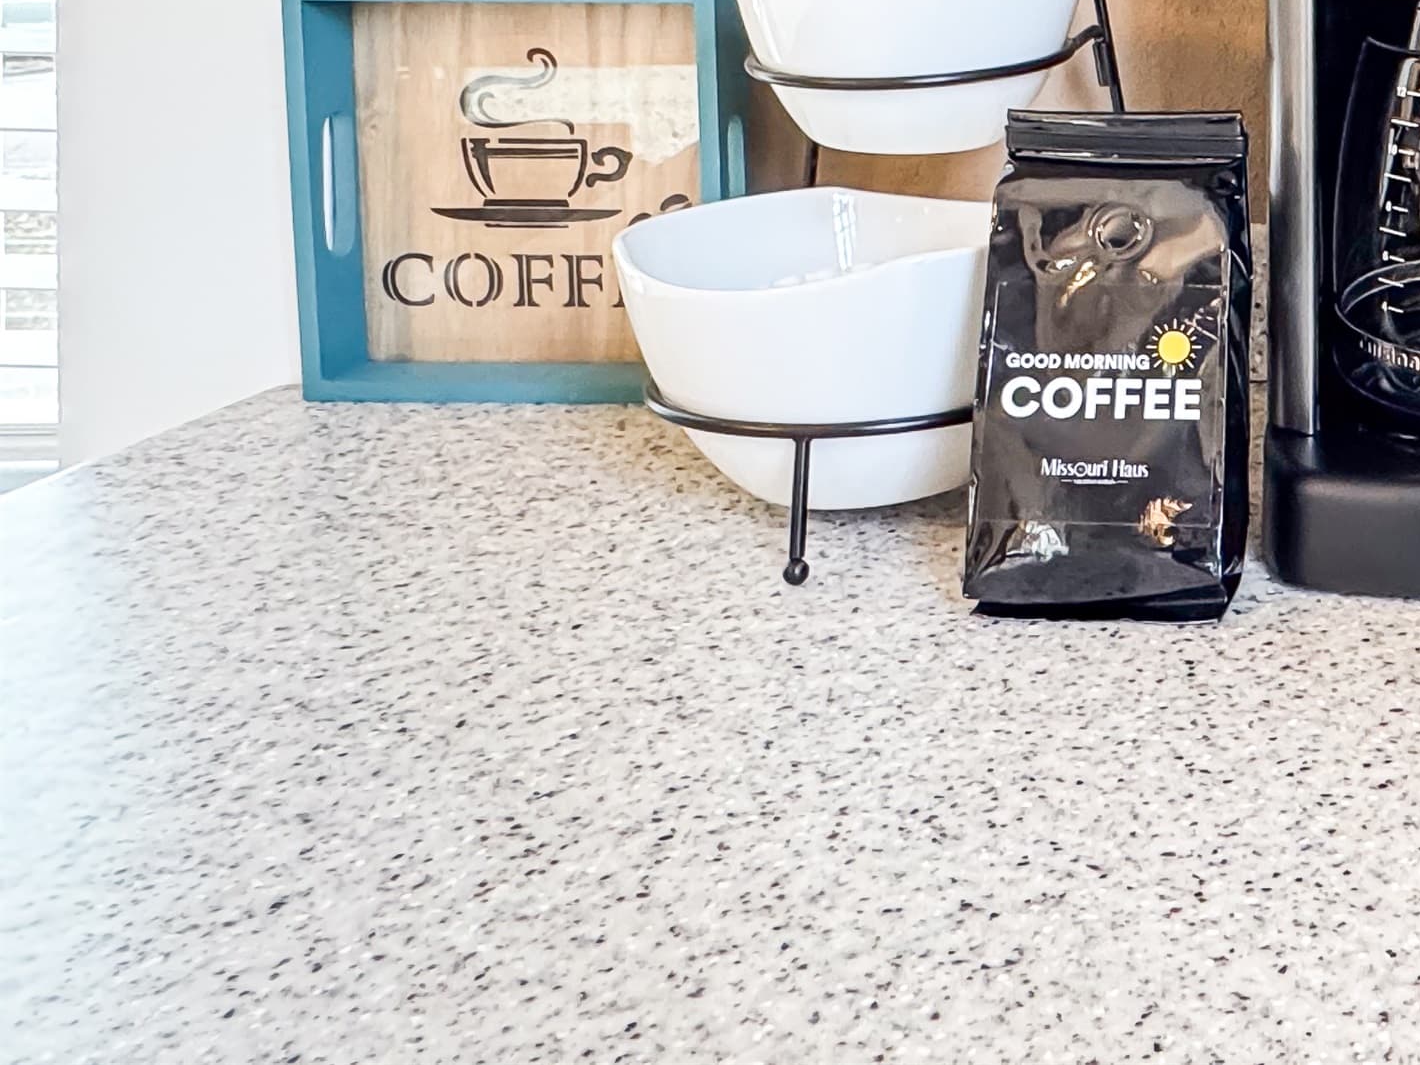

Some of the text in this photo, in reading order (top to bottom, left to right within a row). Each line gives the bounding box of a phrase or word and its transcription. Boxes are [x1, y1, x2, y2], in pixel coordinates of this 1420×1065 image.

[381, 252, 627, 309] COFF
[1005, 352, 1150, 370] GOOD MORNING
[1001, 376, 1202, 420] COFFEE
[1041, 457, 1149, 478] Missouri Haus
